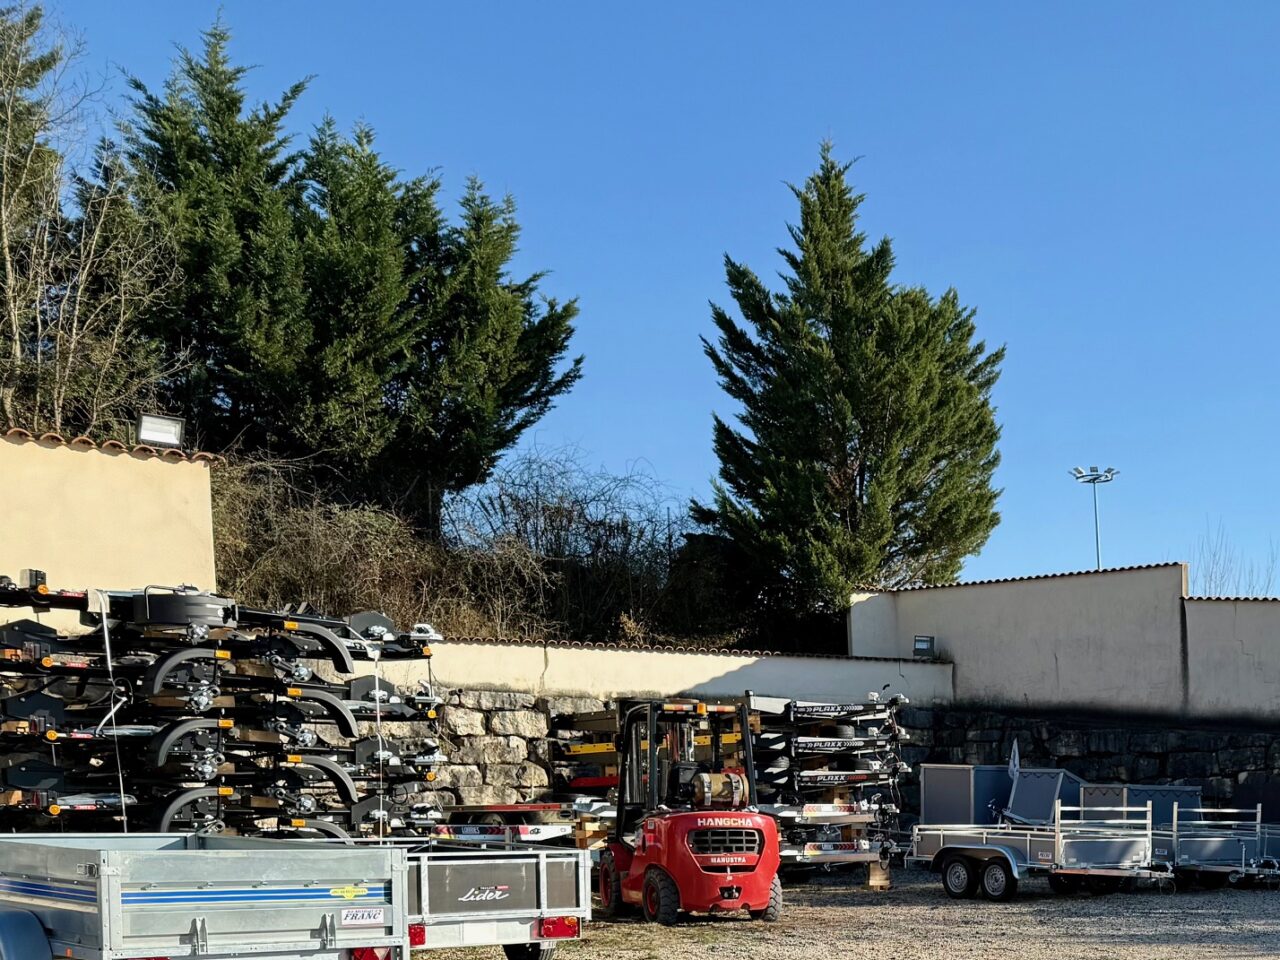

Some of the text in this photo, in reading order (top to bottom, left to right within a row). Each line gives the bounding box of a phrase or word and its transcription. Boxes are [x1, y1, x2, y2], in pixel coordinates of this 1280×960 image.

[697, 817, 753, 827] HANGCHA
[457, 887, 510, 901] Lider
[343, 912, 381, 921] FRANC
